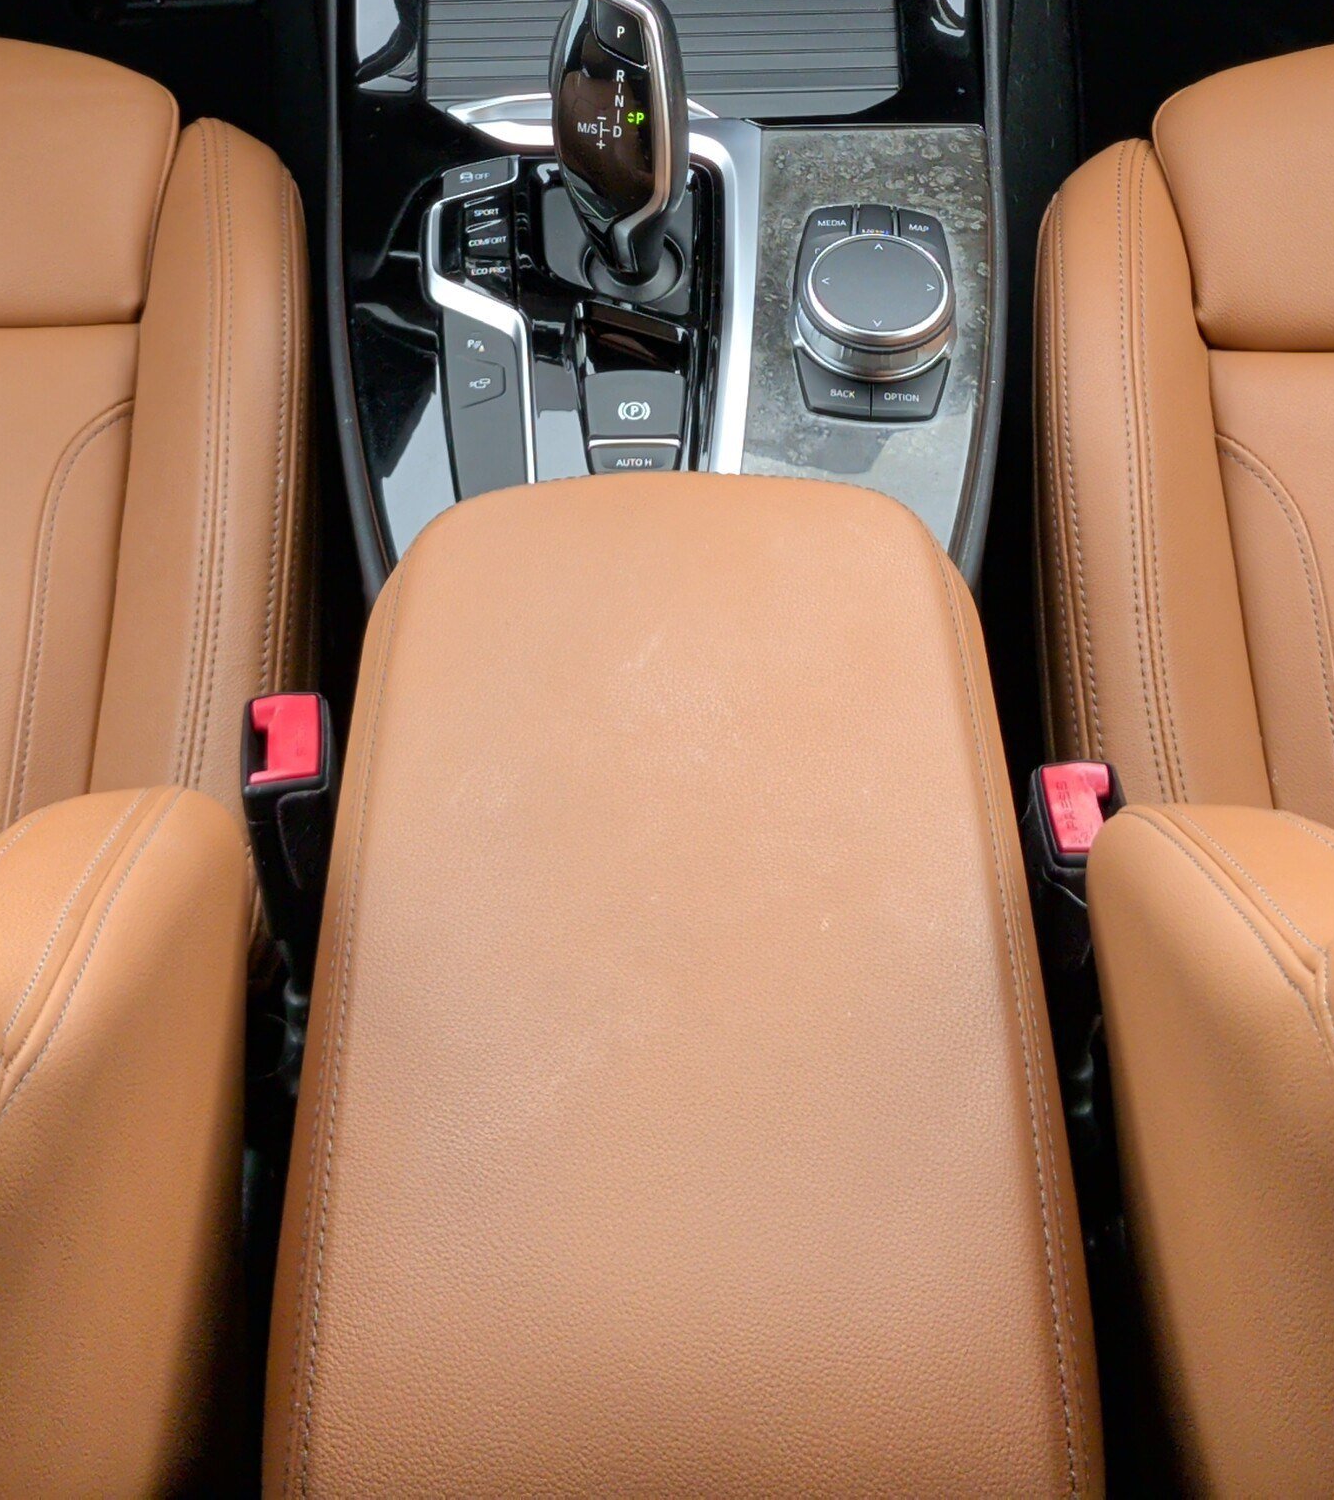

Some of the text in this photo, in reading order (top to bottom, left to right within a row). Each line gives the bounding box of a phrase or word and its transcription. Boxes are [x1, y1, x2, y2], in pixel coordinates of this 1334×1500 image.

[617, 26, 625, 38] P
[616, 69, 625, 82] R
[614, 95, 624, 108] N
[636, 112, 645, 125] P
[577, 122, 598, 134] M/S
[613, 125, 622, 138] D
[475, 172, 491, 180] OFF
[474, 207, 500, 217] SPORT
[817, 219, 847, 227] MEDIA
[908, 223, 930, 233] MAP
[469, 236, 507, 248] COMFORT
[471, 265, 506, 276] ECO PRO
[830, 388, 856, 399] BACK
[883, 391, 920, 403] OPTION
[616, 458, 653, 467] AUTO H
[1056, 780, 1078, 831] PRESS
